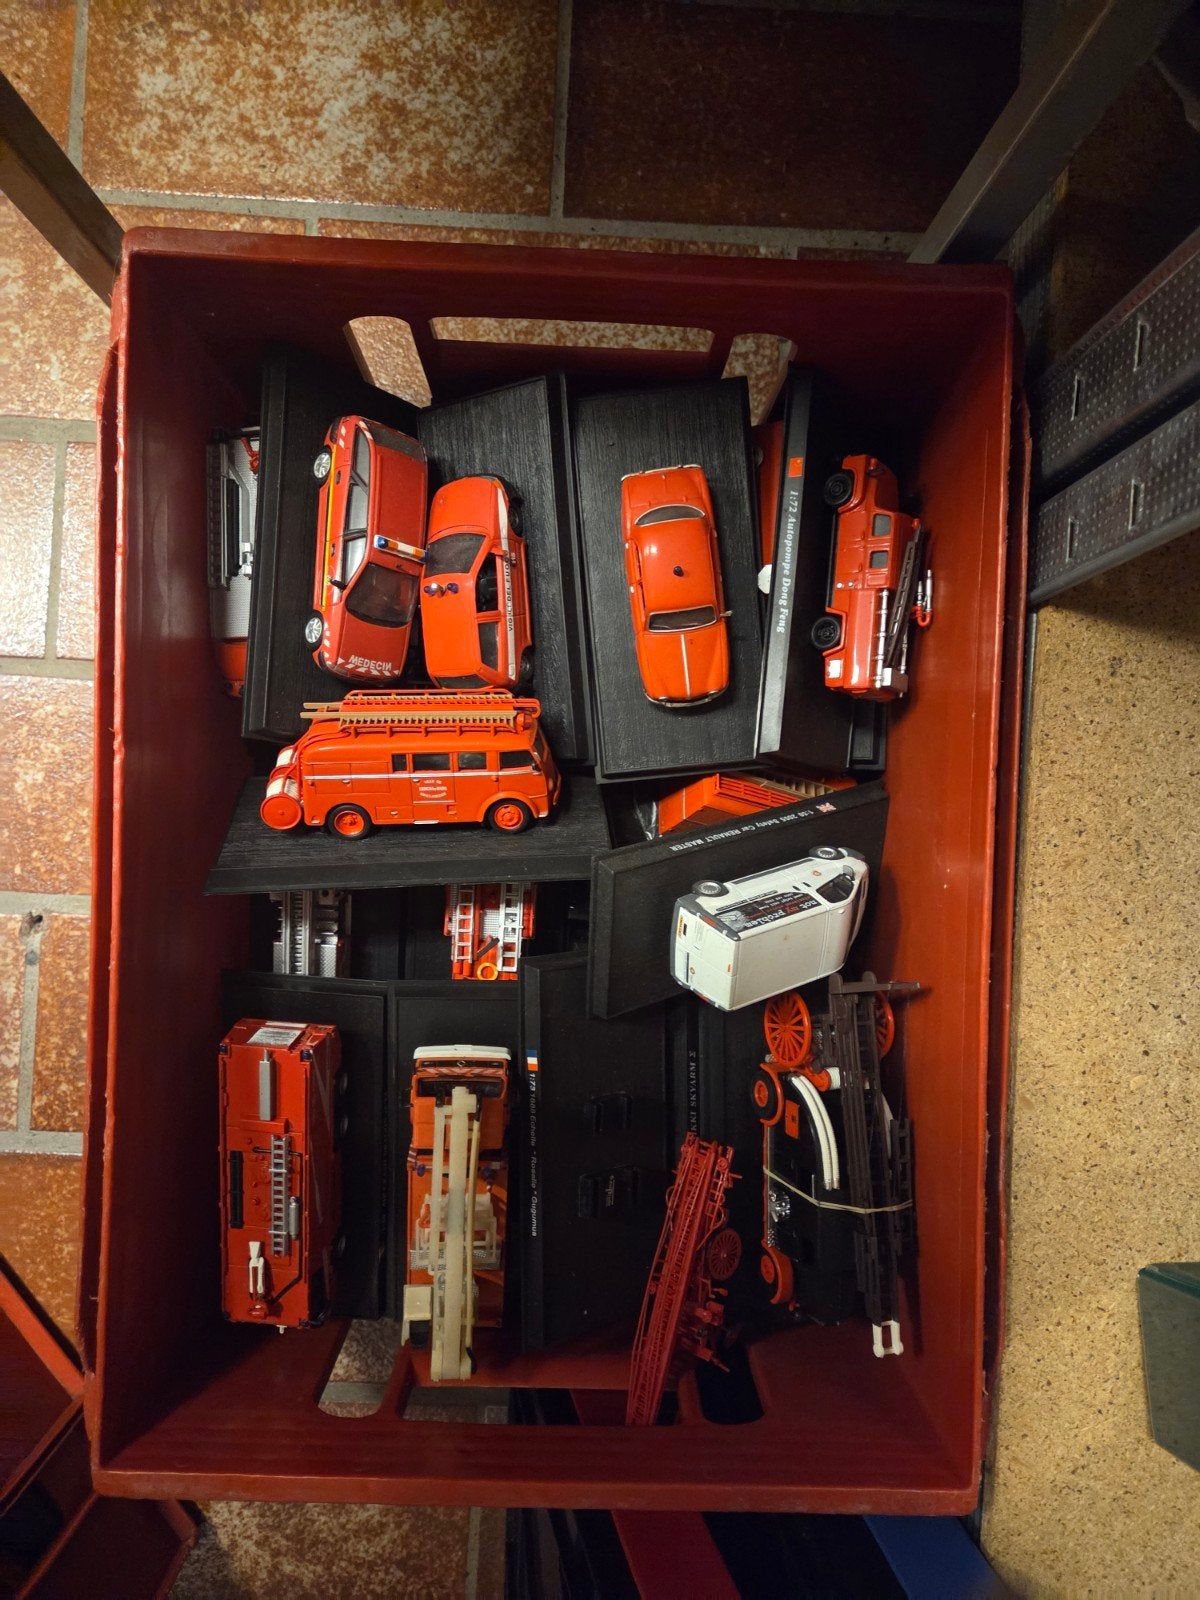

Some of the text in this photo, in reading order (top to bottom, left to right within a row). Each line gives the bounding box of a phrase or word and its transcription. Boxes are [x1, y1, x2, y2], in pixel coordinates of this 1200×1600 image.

[776, 490, 799, 634] 1:72 Autopompe Dong Feng
[756, 818, 780, 828] Safety
[705, 828, 742, 843] RENAULT
[668, 839, 704, 852] MASTER
